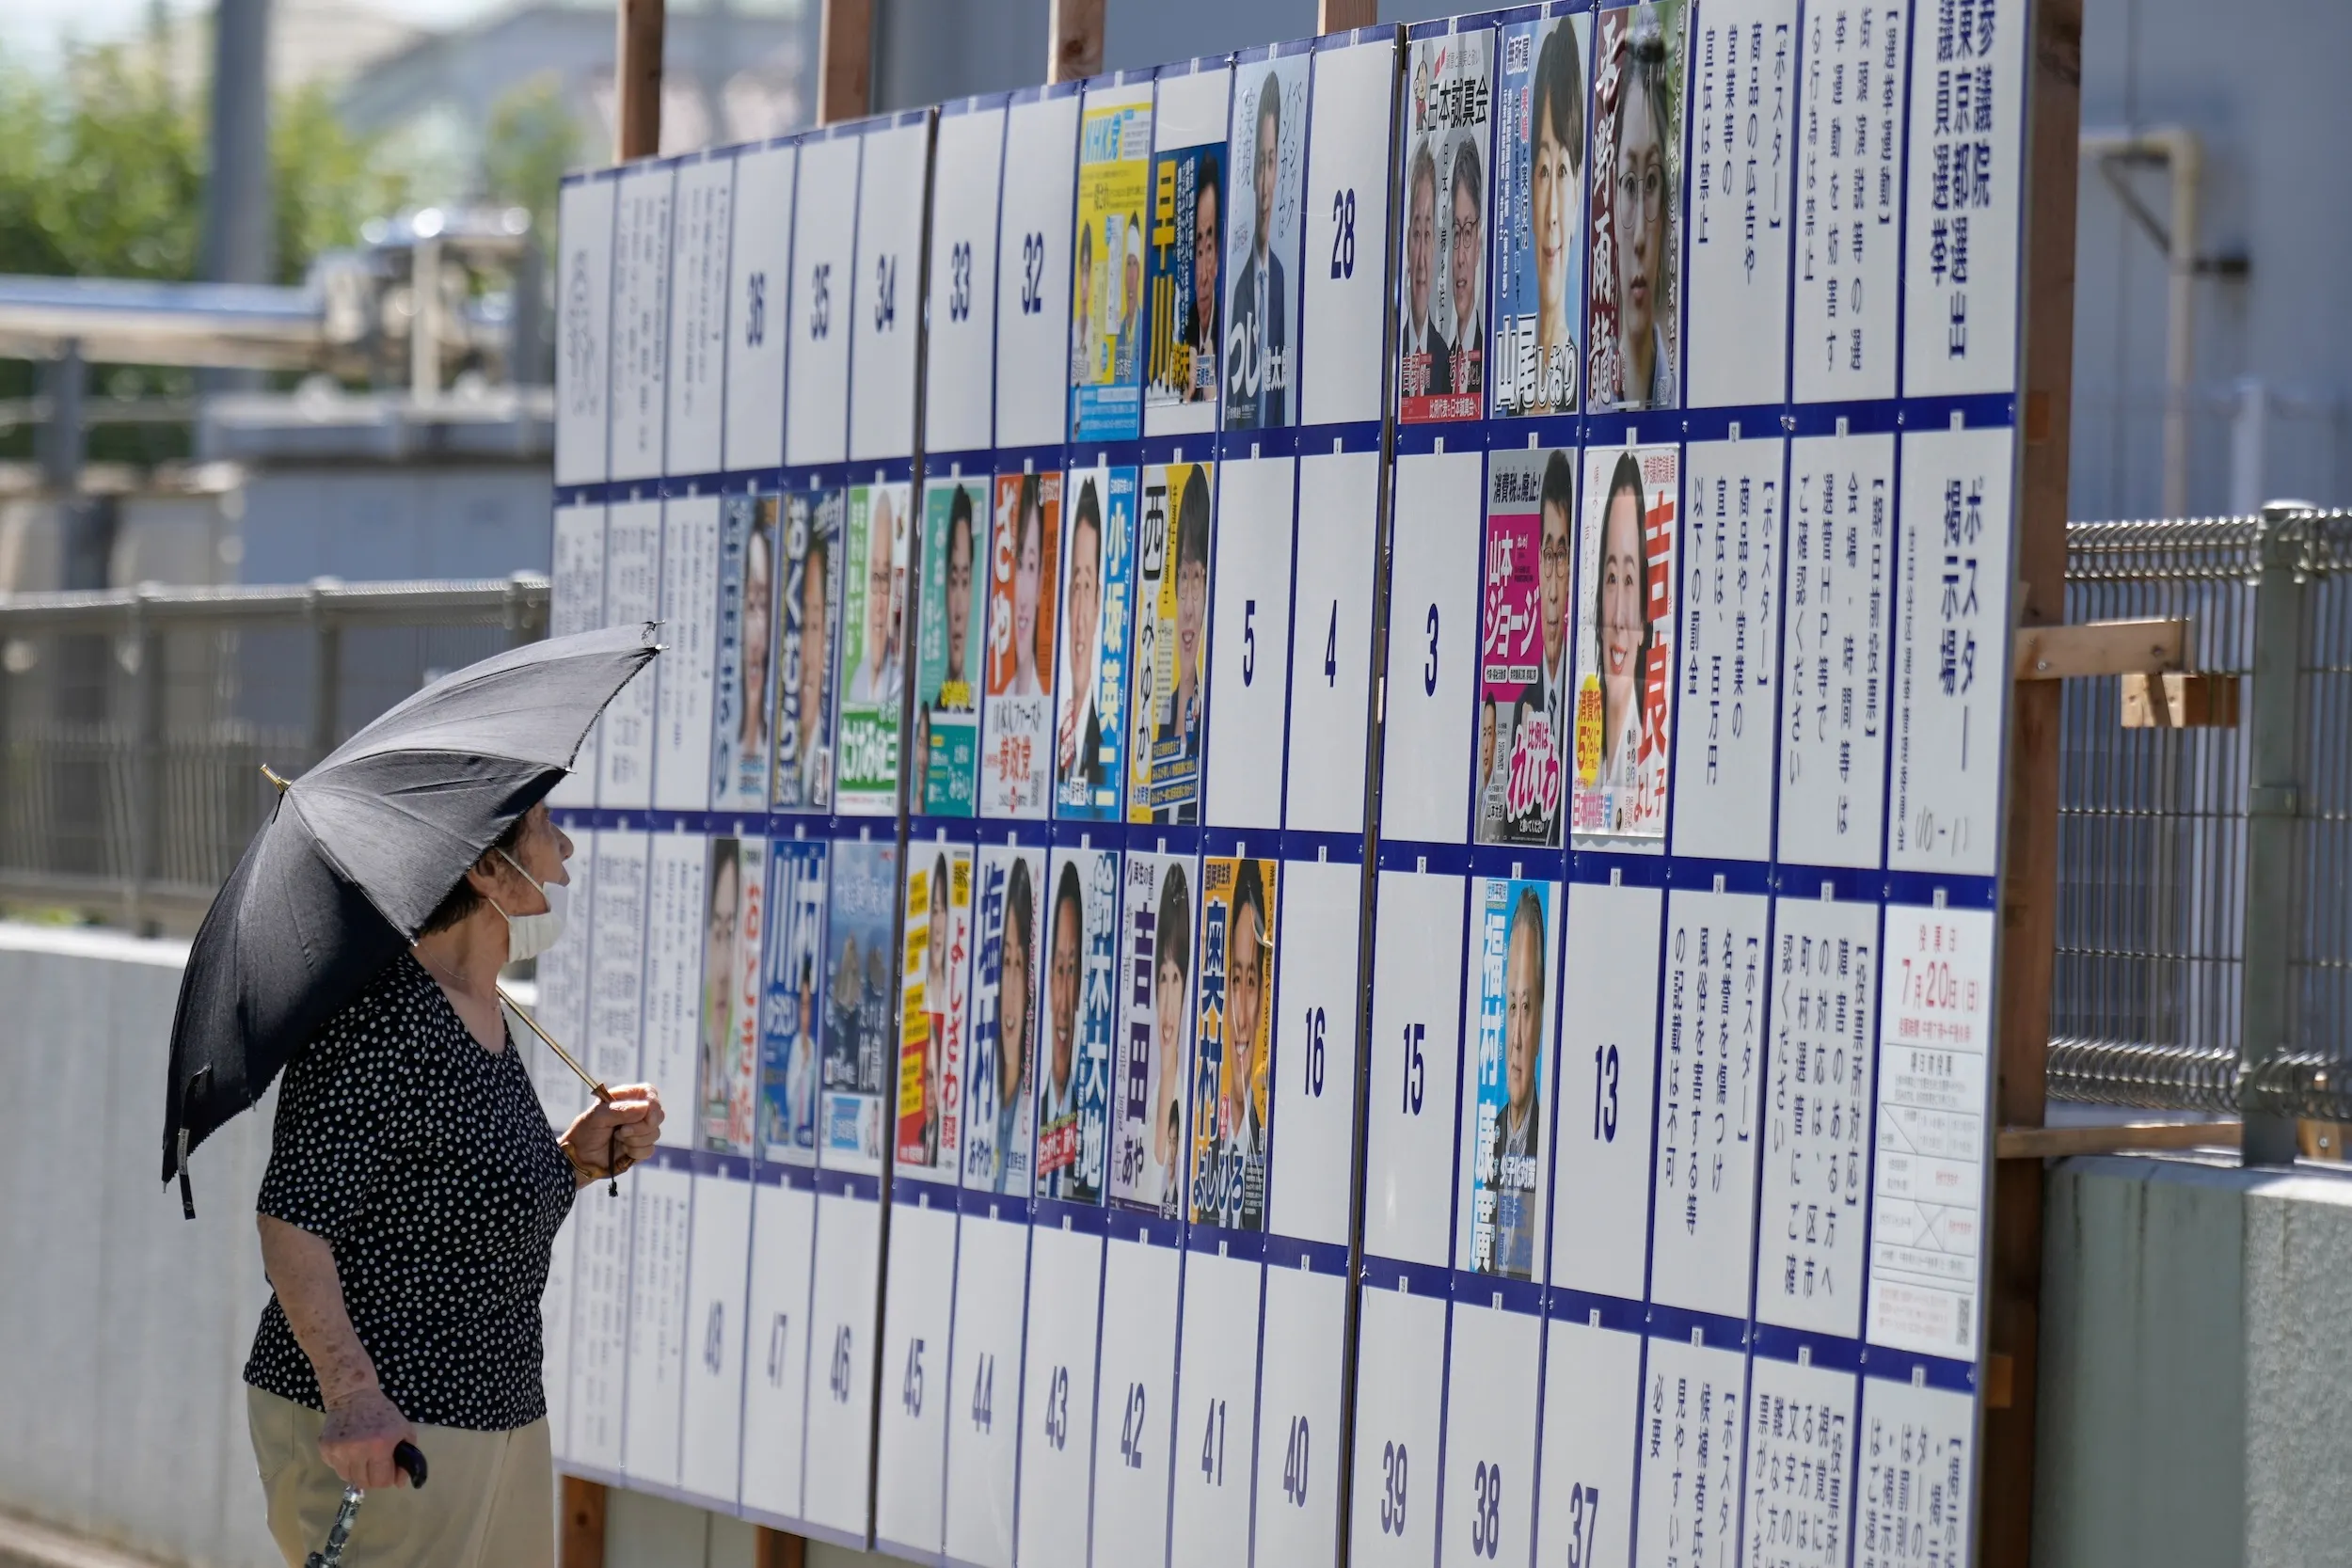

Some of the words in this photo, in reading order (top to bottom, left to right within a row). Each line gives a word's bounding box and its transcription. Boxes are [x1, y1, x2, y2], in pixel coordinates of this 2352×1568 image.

[1428, 75, 1488, 132] 日本誠真会
[1698, 26, 1716, 244] 宣伝は禁止
[1723, 24, 1738, 196] 営業等の
[1744, 21, 1762, 285] 商品の広告や
[1769, 24, 1788, 229] 【ポスター】
[1804, 15, 1821, 282] る行為は禁止
[1930, 0, 1955, 287] 議員選挙
[1971, 0, 1995, 209] 参議院
[1520, 86, 1530, 249] 実績と実行力
[1948, 0, 1975, 360] 東京都選出
[950, 241, 971, 323] 33
[1022, 231, 1043, 315] 32
[1148, 160, 1176, 391] 早川
[1330, 188, 1355, 279] 28
[811, 263, 831, 341] 35
[875, 254, 896, 333] 34
[1495, 313, 1578, 413] 山尾しおり
[1493, 472, 1542, 504] 消費税は廃止!
[1644, 454, 1676, 484] 参議院議員
[990, 482, 1014, 690] さや
[1489, 530, 1513, 587] 山本
[1688, 477, 1704, 694] 以下の罰金
[1731, 475, 1752, 741] 商品や営業の
[1757, 481, 1775, 687] 【ポスター】
[1865, 476, 1885, 739] 【期日前投票】
[1939, 479, 1962, 699] 掲示場
[1096, 501, 1128, 807] 小坂英二
[1136, 484, 1167, 764] 西みゆか
[1243, 600, 1255, 688] 5
[1325, 599, 1337, 688] 4
[1425, 603, 1438, 697] 3
[1484, 585, 1540, 657] ジョージ
[1638, 490, 1675, 768] 吉良
[1707, 476, 1728, 786] 宣伝は、百万円
[1789, 474, 1811, 786] ご確認ください
[1960, 477, 1985, 772] ポスター
[993, 701, 1043, 735] 日本人ファースト
[1528, 721, 1549, 751] 比例は
[1577, 725, 1600, 771] 5%に
[1578, 689, 1601, 723] 消費税
[1000, 734, 1032, 782] 参政党
[1508, 734, 1558, 815] れいわ
[1634, 768, 1665, 823] よし子
[1573, 793, 1613, 829] 日本共産党
[1134, 861, 1154, 886] 再生の道
[1204, 863, 1231, 892] 国民民主党
[766, 857, 827, 995] 川村
[1919, 925, 1956, 952] 投票日
[972, 861, 1005, 1127] 塩村
[1081, 853, 1115, 1189] 鈴木大地
[1126, 901, 1155, 1124] 吉田
[1198, 898, 1227, 1141] 奥村
[1901, 958, 1979, 1014] 7月20日(日)
[1305, 1006, 1326, 1098] 16
[1403, 1023, 1424, 1116] 15
[1665, 927, 1687, 1188] の記載は不可
[1686, 926, 1708, 1237] 風俗を害する等
[1711, 927, 1733, 1195] 名誉を傷つけ
[1737, 936, 1757, 1143] 【ポスター】
[1774, 933, 1794, 1155] 認ください
[1845, 943, 1868, 1209] 【投票所対応】
[1594, 1044, 1618, 1143] 13
[1784, 935, 1813, 1296] 町村選管にご確
[1820, 937, 1851, 1302] 障害のある方へ
[968, 1134, 993, 1178] あやか
[1122, 1133, 1145, 1189] あや
[1192, 1146, 1246, 1214] よしひろ
[1500, 1155, 1536, 1189] 少子化対策
[705, 1302, 723, 1374] 48
[769, 1314, 787, 1385] 47
[831, 1325, 851, 1403] 46
[903, 1338, 925, 1418] 45
[972, 1353, 993, 1434] 44
[1045, 1366, 1068, 1451] 43
[1120, 1383, 1145, 1468] 42
[1201, 1398, 1225, 1486] 41
[1650, 1372, 1664, 1460] 必要
[1283, 1416, 1309, 1507] 40
[1381, 1440, 1407, 1537] 39
[1472, 1461, 1501, 1560] 38
[1666, 1377, 1687, 1568] 見やすい
[1692, 1381, 1711, 1568] 候補者氏
[1766, 1396, 1785, 1568] 難な方
[1780, 1399, 1800, 1568] 文字の
[1879, 1433, 1895, 1568] ・掲示
[1895, 1423, 1913, 1568] は罰則
[1567, 1482, 1598, 1568] 37
